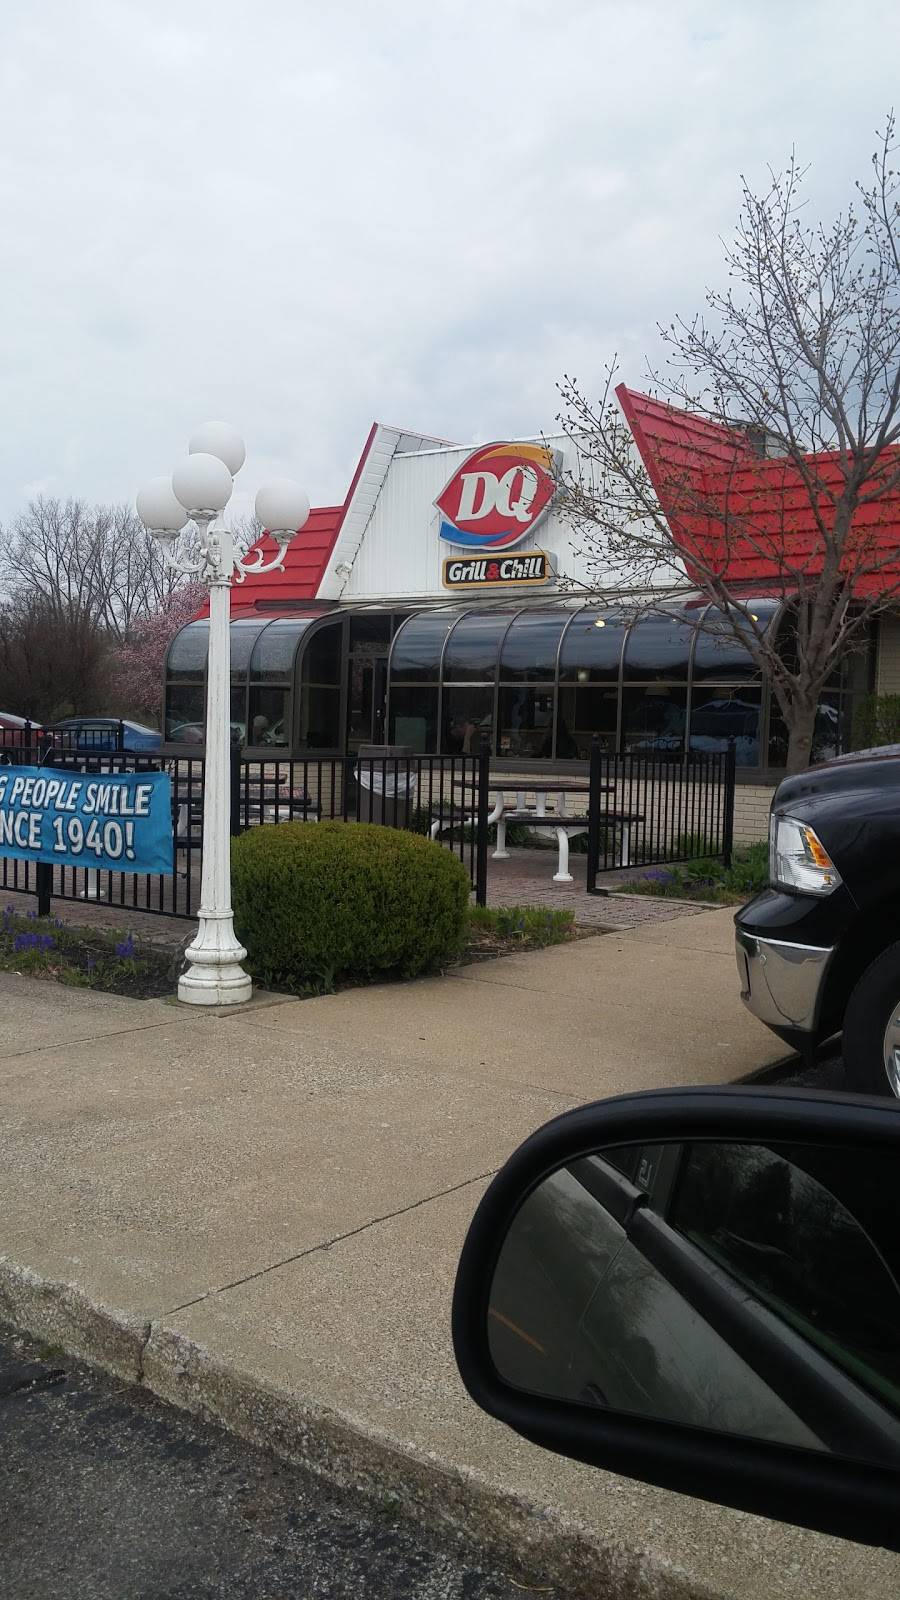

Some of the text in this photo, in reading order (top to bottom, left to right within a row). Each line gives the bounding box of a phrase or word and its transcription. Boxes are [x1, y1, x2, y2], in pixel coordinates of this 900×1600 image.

[455, 465, 538, 523] DQ
[9, 776, 82, 812] PEOPLE
[82, 783, 152, 816] SMILE
[53, 815, 136, 861] 1940!
